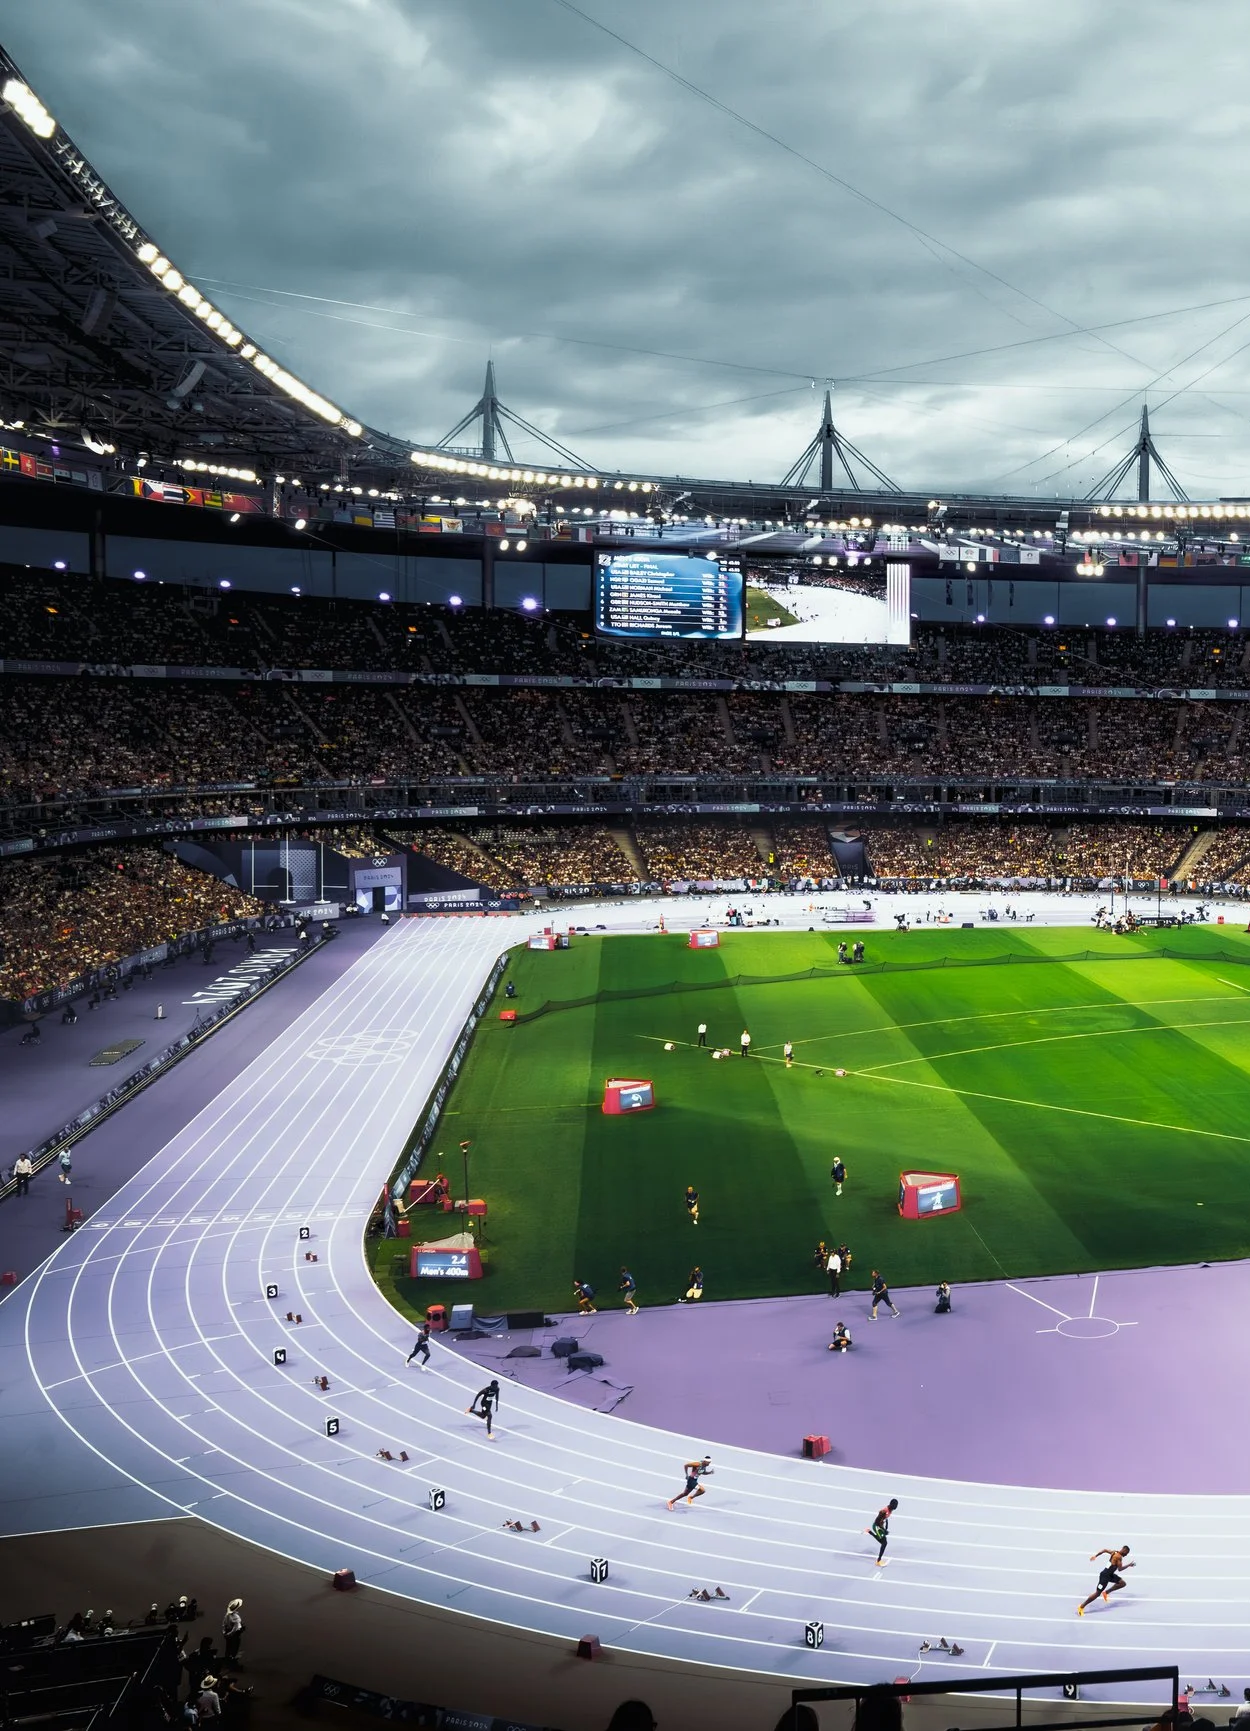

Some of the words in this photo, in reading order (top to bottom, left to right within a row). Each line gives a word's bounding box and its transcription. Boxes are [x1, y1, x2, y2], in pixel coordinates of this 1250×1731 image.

[301, 1230, 308, 1238] 2
[451, 1255, 466, 1264] 2.4
[420, 1266, 444, 1276] Men's
[446, 1267, 468, 1276] 400m
[268, 1287, 276, 1296] 3
[276, 1353, 284, 1361] 4
[330, 1423, 338, 1431] 5
[436, 1497, 443, 1507] 6
[591, 1565, 597, 1577] 7
[601, 1565, 607, 1577] 7
[807, 1631, 814, 1644] 8
[1065, 1684, 1074, 1696] 9
[445, 1716, 467, 1727] PARIS
[469, 1720, 488, 1729] 2024
